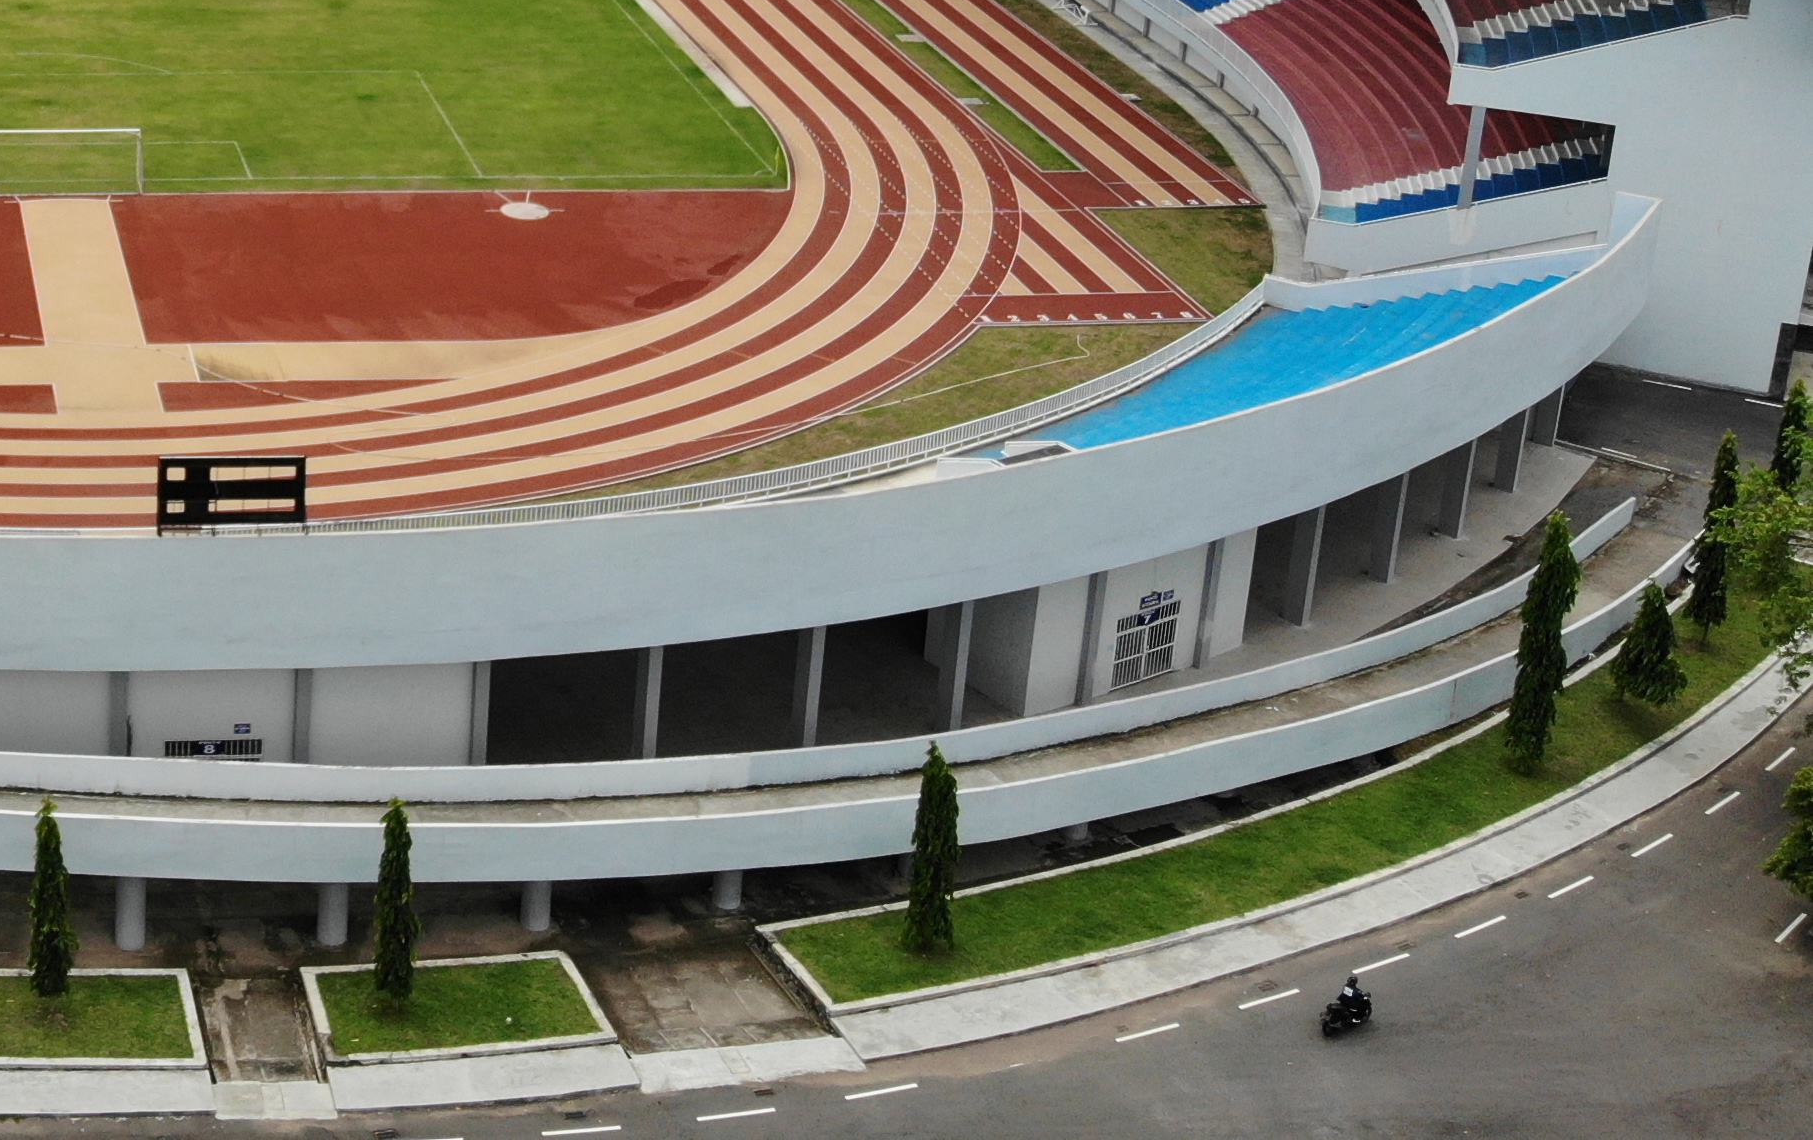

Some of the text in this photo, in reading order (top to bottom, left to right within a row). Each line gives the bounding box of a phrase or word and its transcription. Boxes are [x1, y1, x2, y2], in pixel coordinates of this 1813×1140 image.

[1007, 314, 1021, 323] 2
[1036, 314, 1051, 322] 3
[1067, 313, 1080, 321] 4
[1122, 312, 1137, 320] 6
[1150, 311, 1164, 319] 7
[1143, 614, 1152, 625] 7
[203, 744, 216, 754] 8
